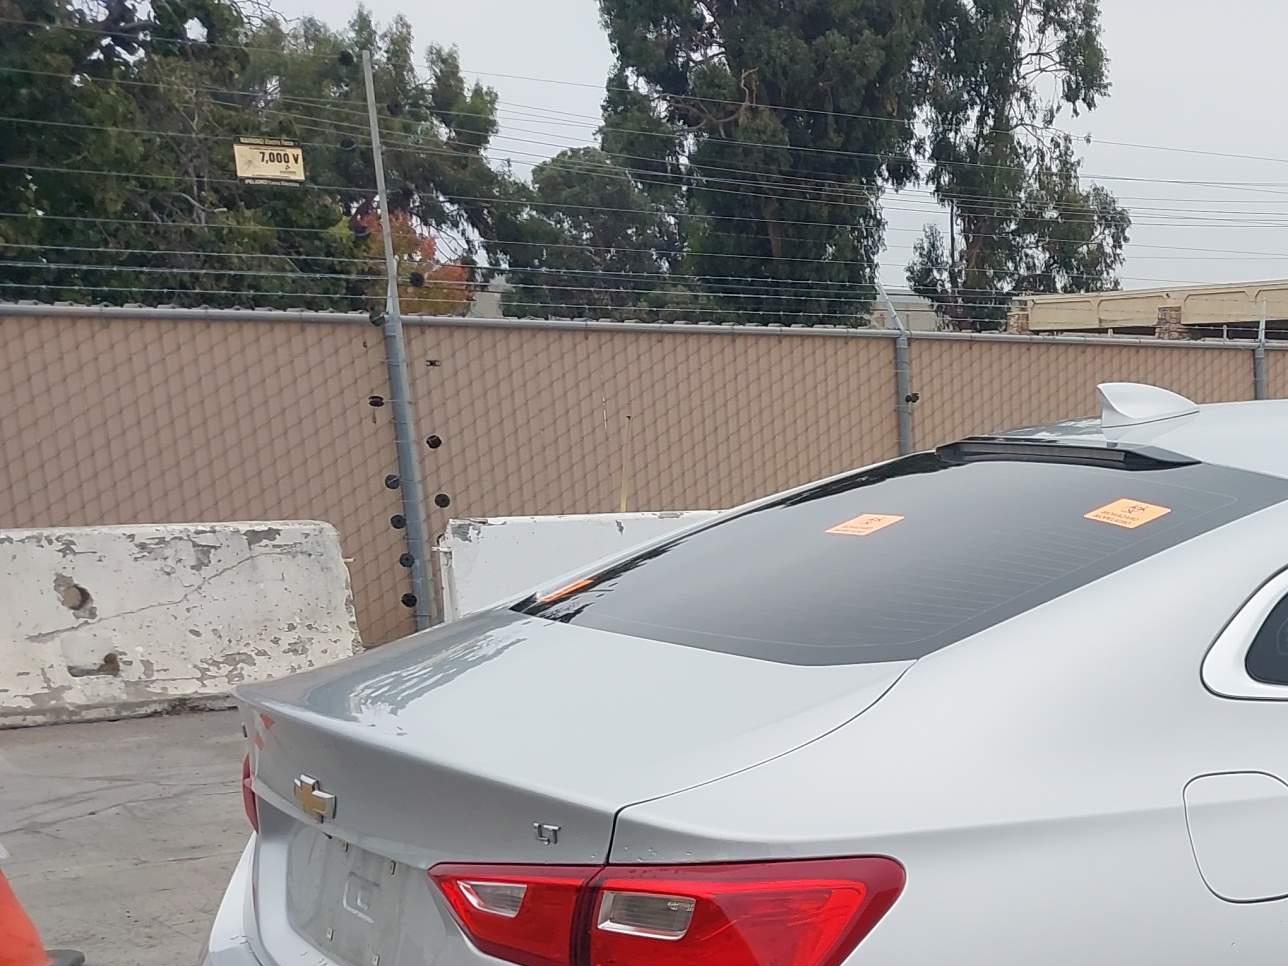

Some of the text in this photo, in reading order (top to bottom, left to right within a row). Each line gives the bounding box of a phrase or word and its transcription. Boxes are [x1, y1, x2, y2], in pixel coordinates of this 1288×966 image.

[259, 151, 300, 165] 7,000 V
[533, 822, 561, 845] LT
